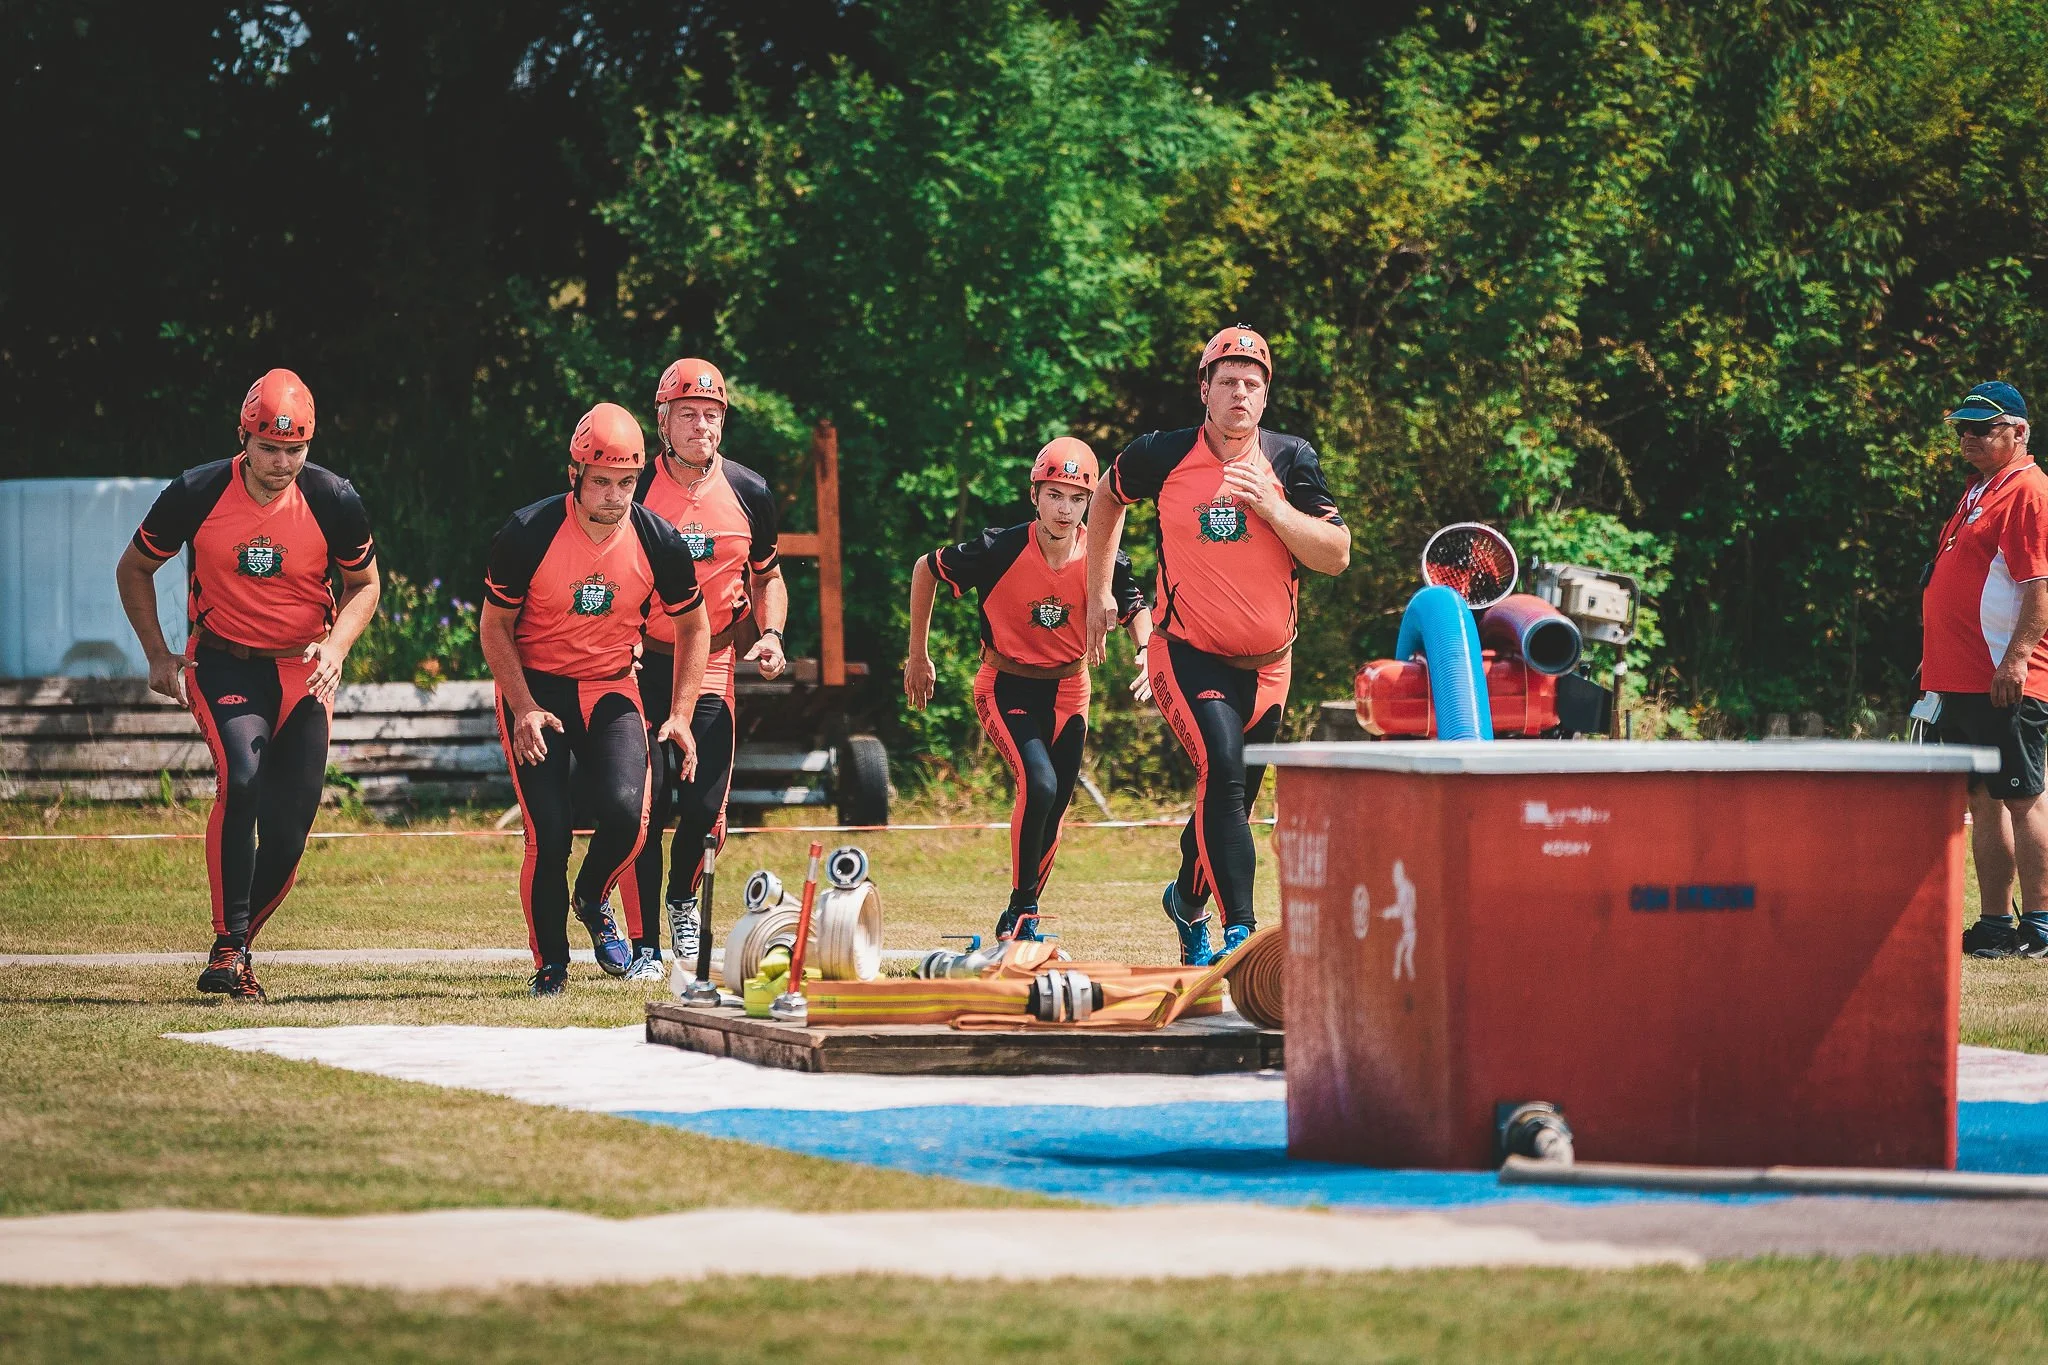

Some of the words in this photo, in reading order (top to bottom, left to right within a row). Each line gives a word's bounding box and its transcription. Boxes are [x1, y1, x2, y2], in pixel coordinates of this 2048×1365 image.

[1234, 347, 1258, 355] CAMP
[270, 429, 295, 437] CAMP
[606, 456, 630, 464] CAMP
[1057, 473, 1081, 481] CAMP
